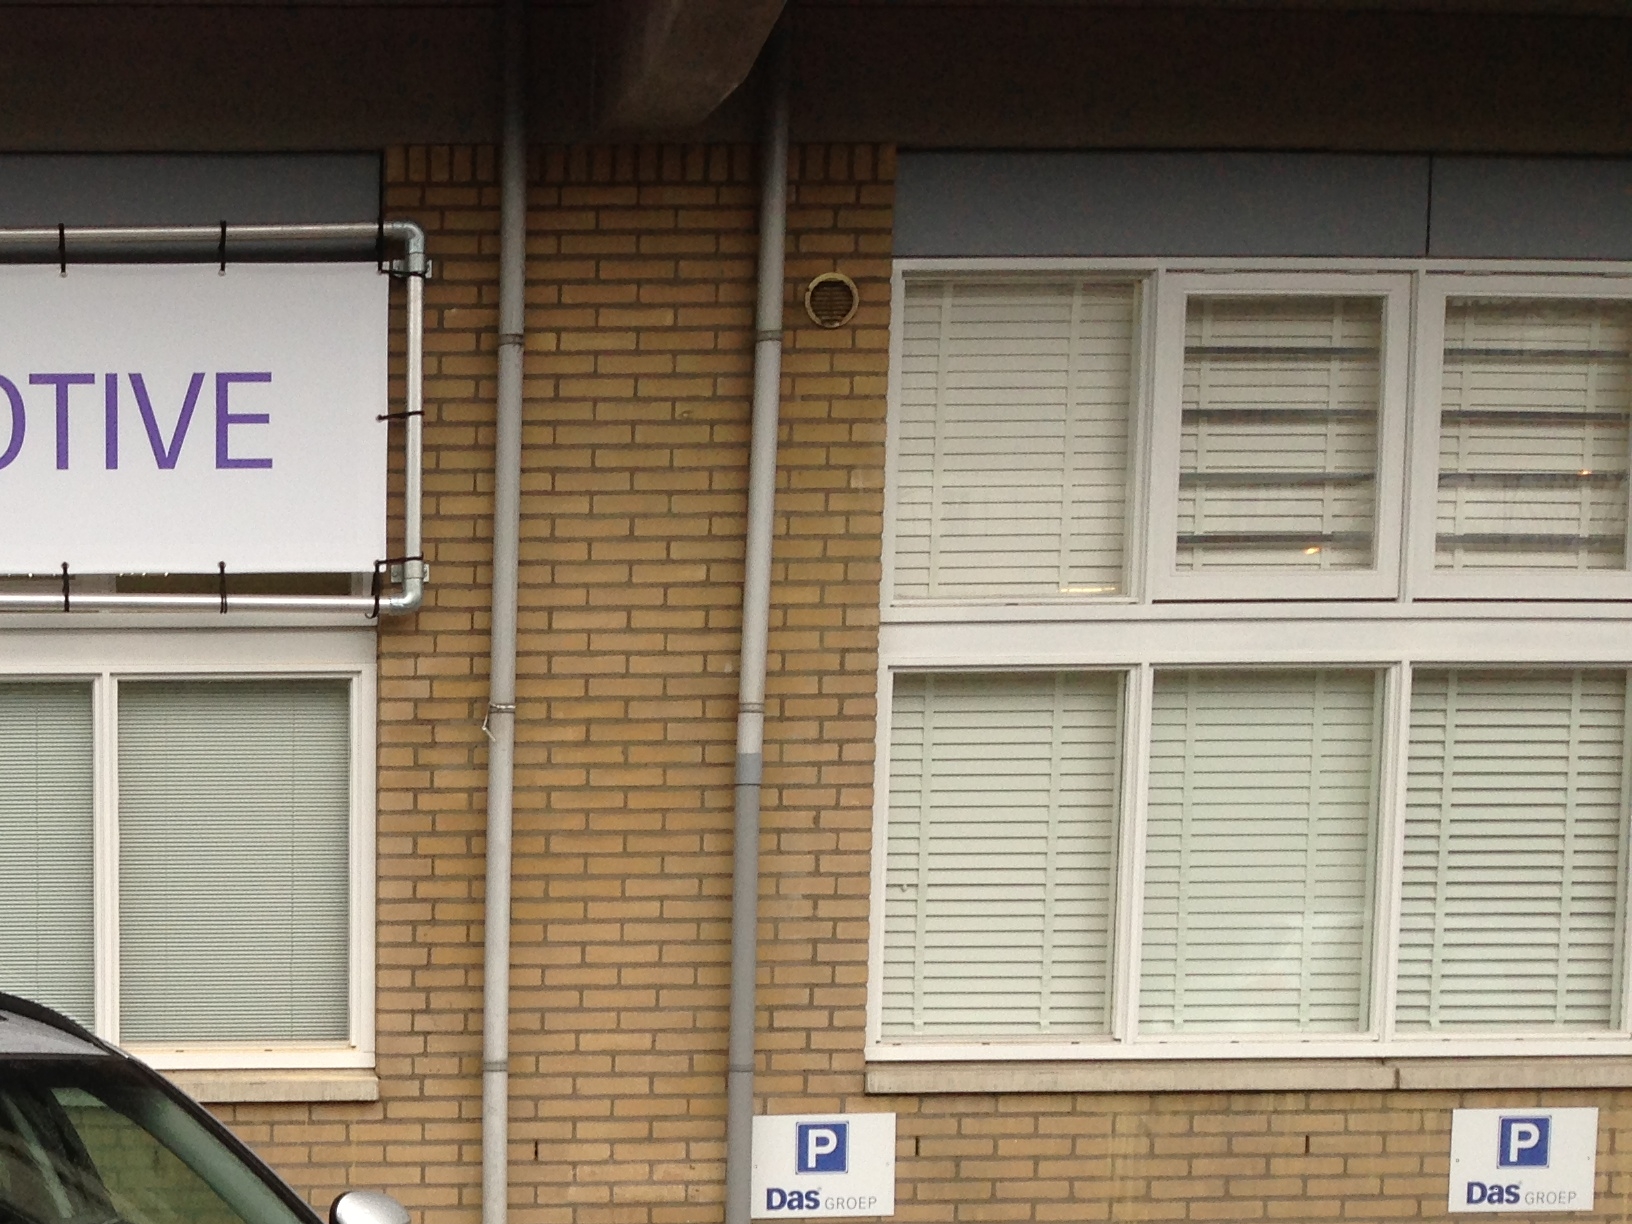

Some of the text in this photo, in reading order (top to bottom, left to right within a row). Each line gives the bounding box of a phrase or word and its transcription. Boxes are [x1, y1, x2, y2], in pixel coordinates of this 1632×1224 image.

[807, 1128, 838, 1169] P
[1509, 1122, 1540, 1163] P
[766, 1187, 878, 1211] Das GROEP
[1466, 1181, 1577, 1206] Das GROEP
